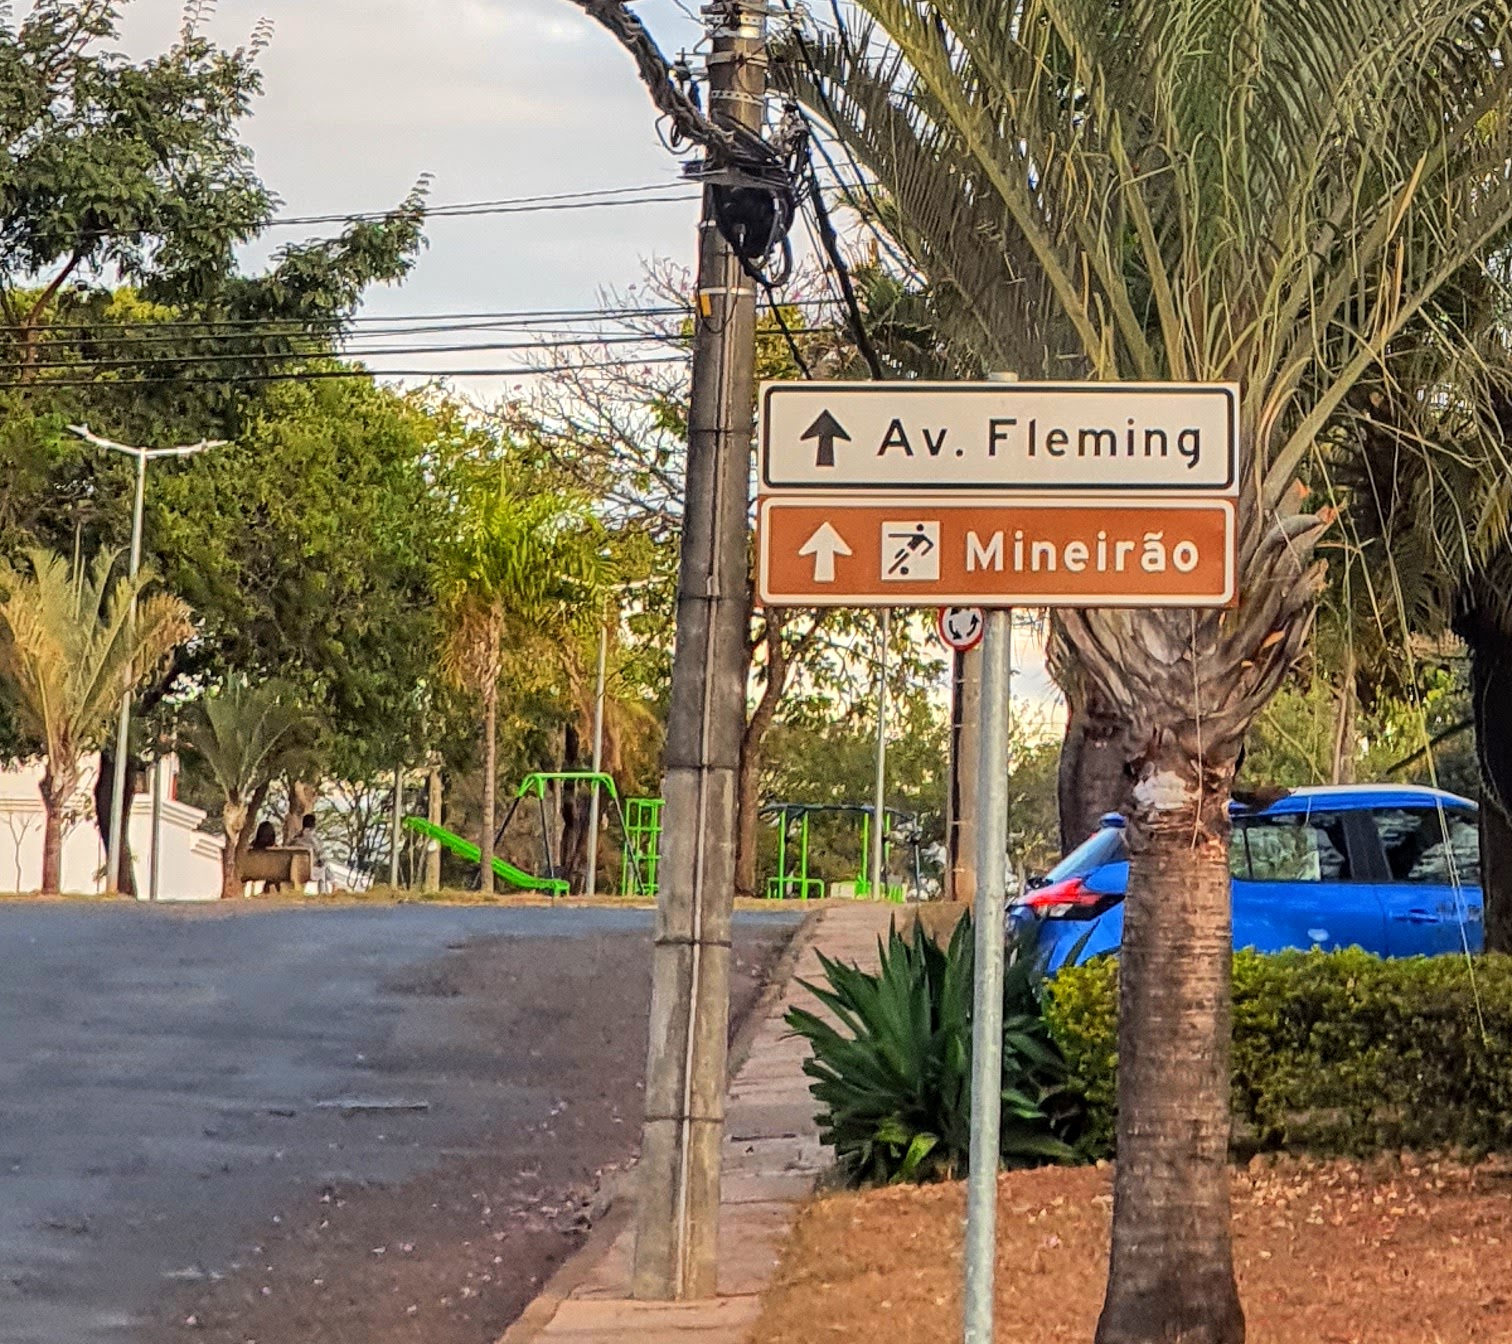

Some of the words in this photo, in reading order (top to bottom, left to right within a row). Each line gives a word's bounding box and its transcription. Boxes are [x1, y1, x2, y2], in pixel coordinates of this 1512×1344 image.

[876, 418, 964, 458] Av.
[987, 418, 1201, 469] Fleming
[965, 530, 1200, 574] Mineirão
